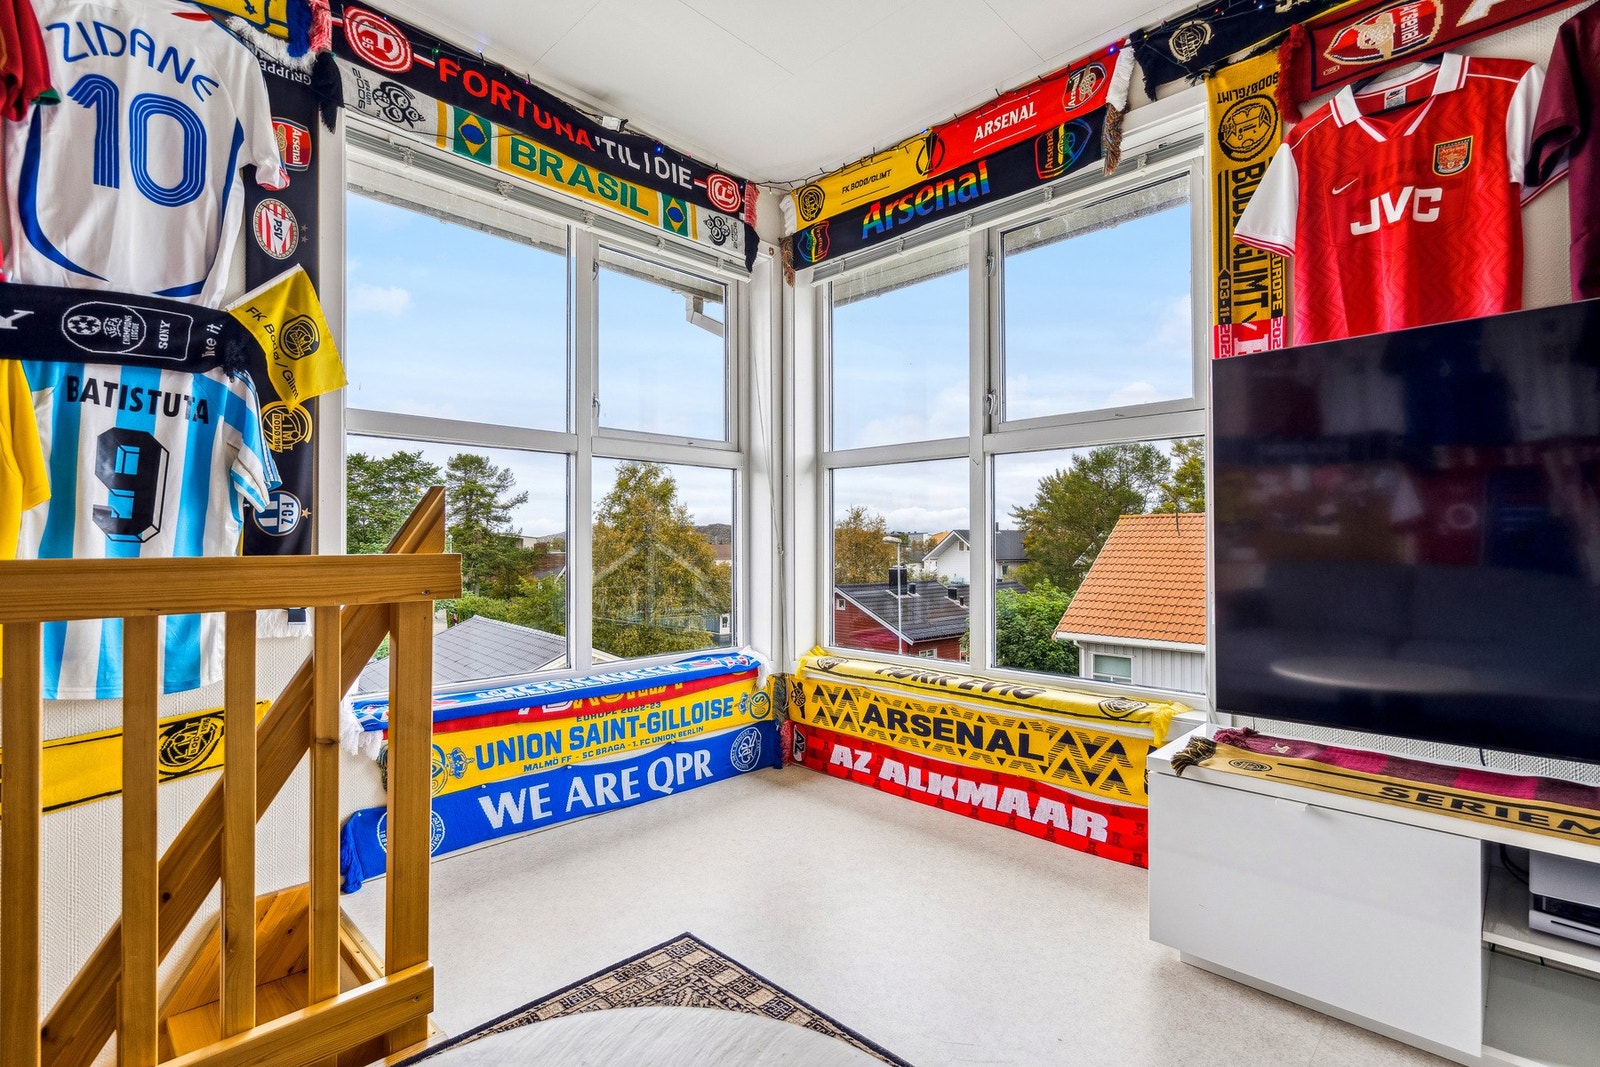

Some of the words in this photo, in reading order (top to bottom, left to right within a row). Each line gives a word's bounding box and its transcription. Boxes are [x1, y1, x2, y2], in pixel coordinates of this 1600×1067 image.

[45, 21, 220, 102] ZIDANE
[259, 60, 312, 86] GRUPPE
[352, 67, 366, 110] 2006
[66, 73, 208, 208] 10
[291, 127, 303, 166] Arsenal
[438, 57, 596, 152] FORTUNA
[653, 156, 693, 190] DIE
[973, 101, 1038, 144] ARSENAL
[510, 136, 650, 217] BRASIL
[861, 159, 991, 240] Arsenal
[273, 218, 283, 241] PSV
[1350, 186, 1443, 236] JVC
[1271, 252, 1284, 311] EUROPE
[110, 317, 121, 338] UEFA
[122, 314, 133, 345] CHAMPIONS
[131, 322, 140, 341] LEAGUE
[158, 320, 172, 350] SONY
[206, 323, 223, 336] it.
[245, 306, 267, 322] FK
[1218, 278, 1231, 359] 03-11-202
[66, 375, 209, 425] BATISTUTA
[92, 426, 170, 543] 9
[281, 502, 294, 525] FCZ
[475, 729, 562, 771] UNION
[569, 696, 735, 752] SAINT-GILLOISE
[523, 756, 560, 773] MALMÖ
[561, 755, 572, 767] FF
[582, 750, 594, 759] SC
[596, 743, 626, 756] BRAGA
[640, 738, 651, 746] FC
[652, 733, 677, 744] UNION
[678, 726, 704, 738] BERLIN
[862, 703, 1046, 762] ARSENAL
[477, 782, 554, 830] WE
[564, 766, 641, 813] ARE
[646, 748, 714, 794] QPR
[830, 744, 872, 774] AZ
[878, 761, 1109, 843] ALKMAAR
